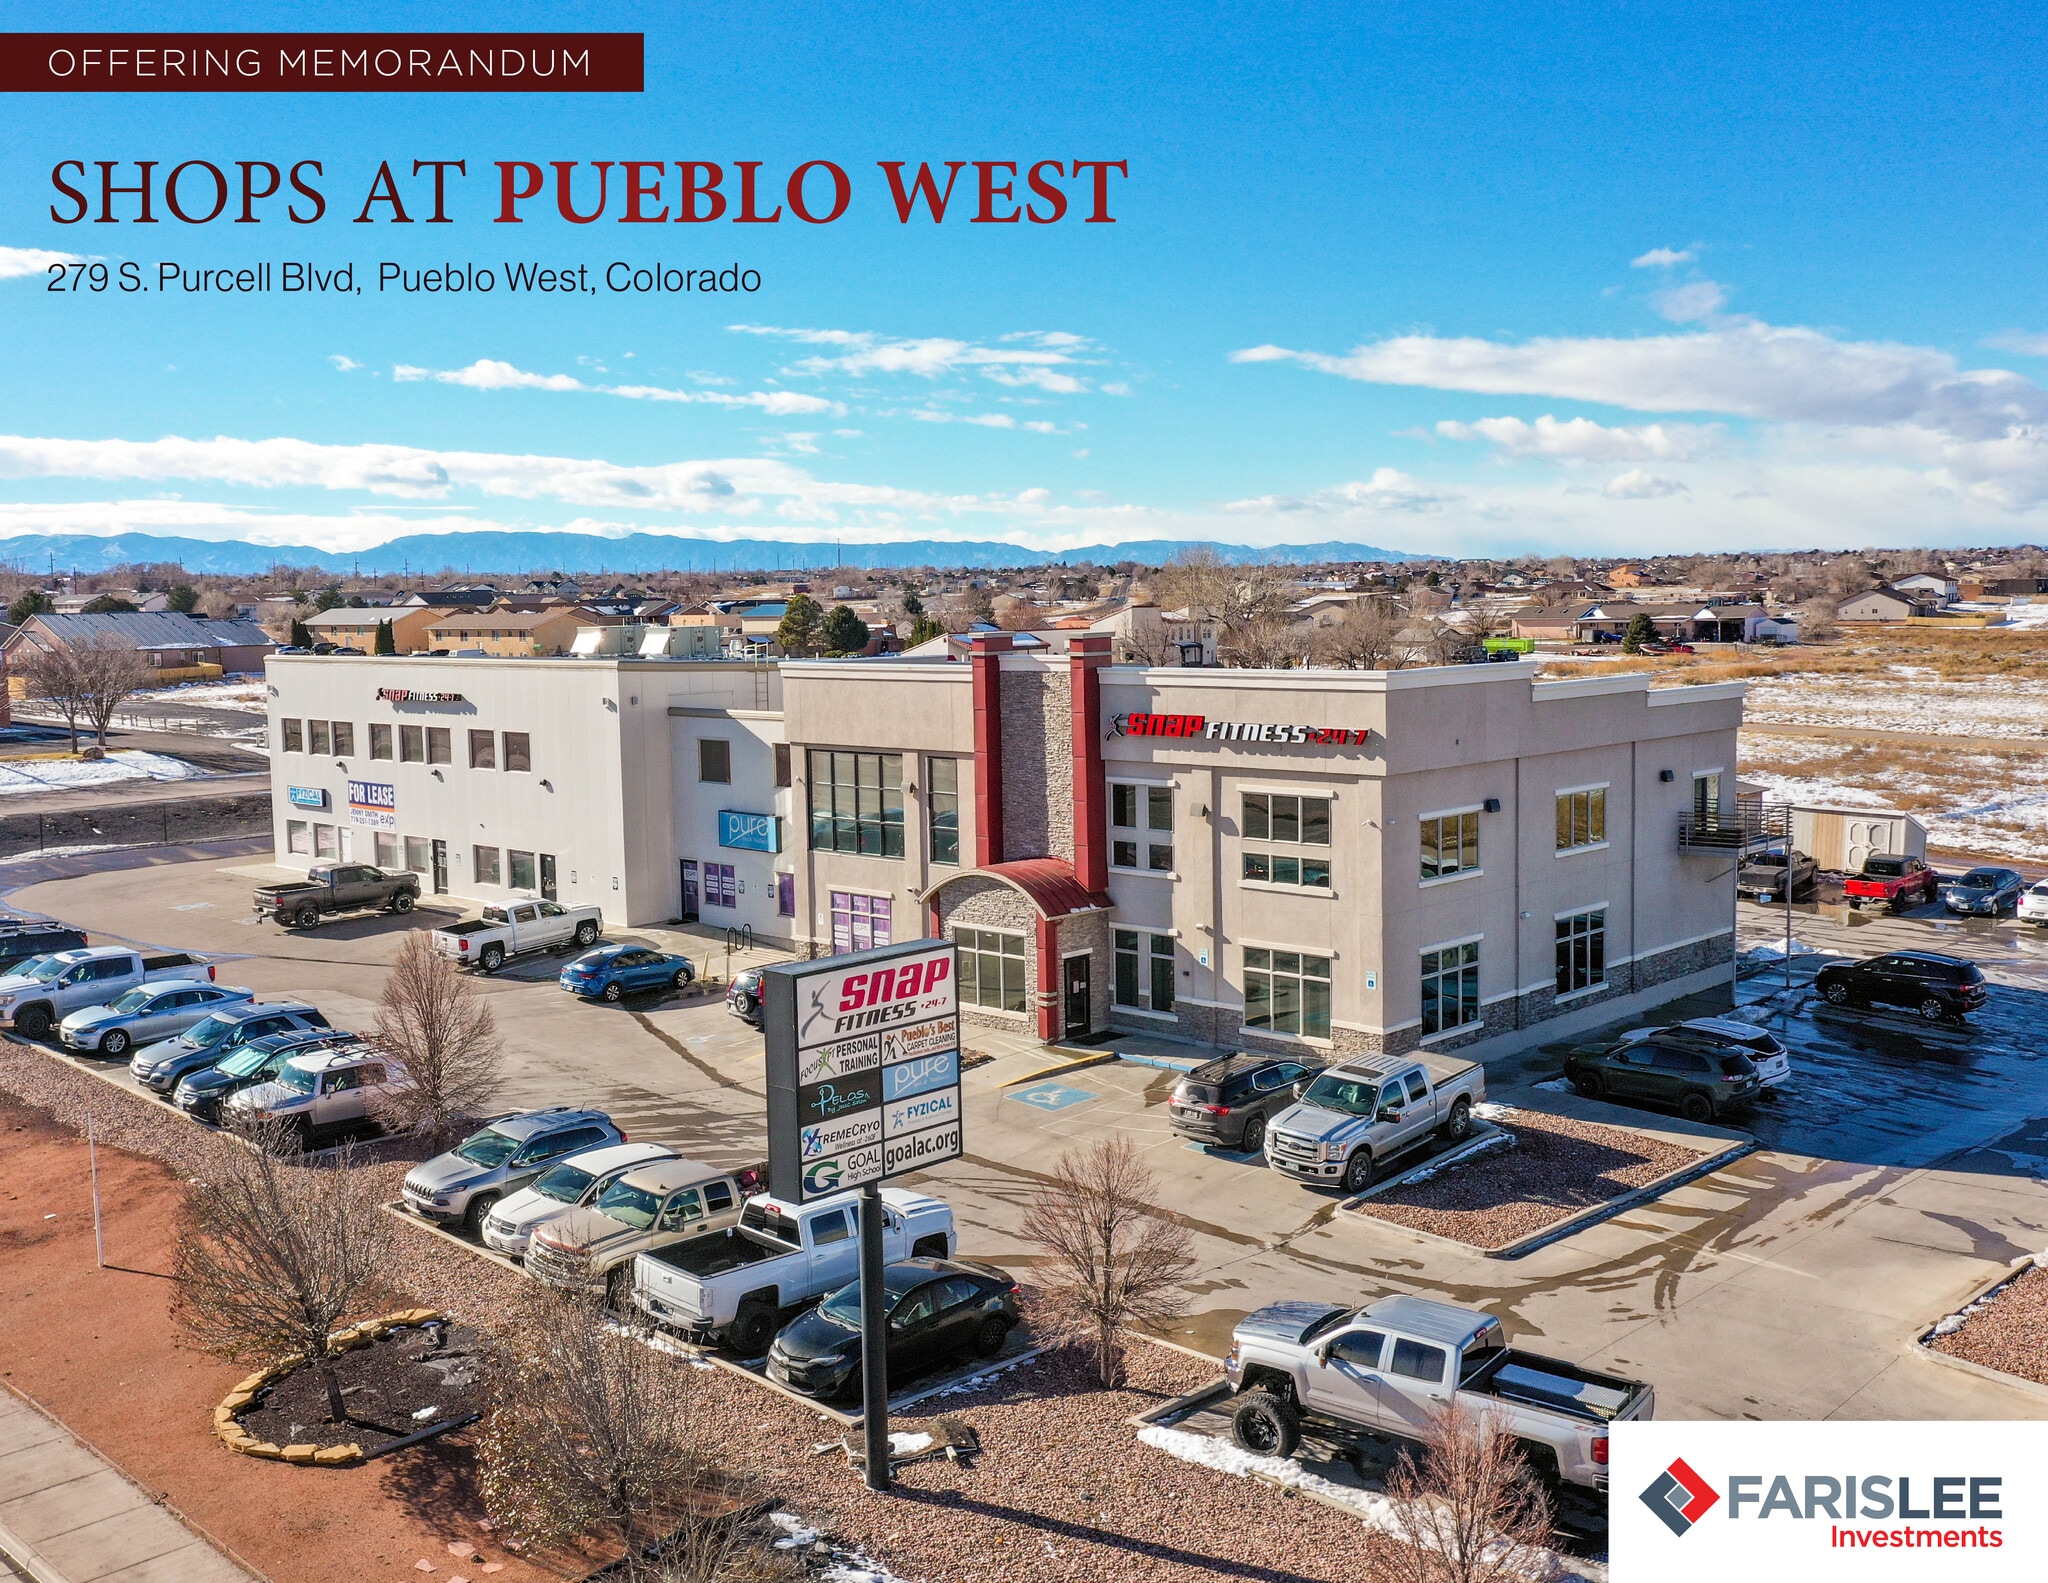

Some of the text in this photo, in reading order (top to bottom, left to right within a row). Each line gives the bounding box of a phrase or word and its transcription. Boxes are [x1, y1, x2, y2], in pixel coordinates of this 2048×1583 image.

[1205, 722, 1309, 744] FITNESS
[349, 783, 394, 806] FOR LEASE
[727, 815, 769, 842] pure
[834, 1000, 918, 1034] FITNESS
[901, 1020, 955, 1043] Pueblo's Best
[907, 1038, 928, 1052] CARPET
[928, 1032, 956, 1046] CLEANING
[836, 1036, 878, 1058] PERSONAL
[840, 1052, 878, 1073] TRAINING
[893, 1055, 950, 1095] pure
[907, 1096, 953, 1119] FYZICAL
[848, 1148, 881, 1170] GOAL
[886, 1130, 958, 1172] goalac.org
[848, 1163, 882, 1182] High School
